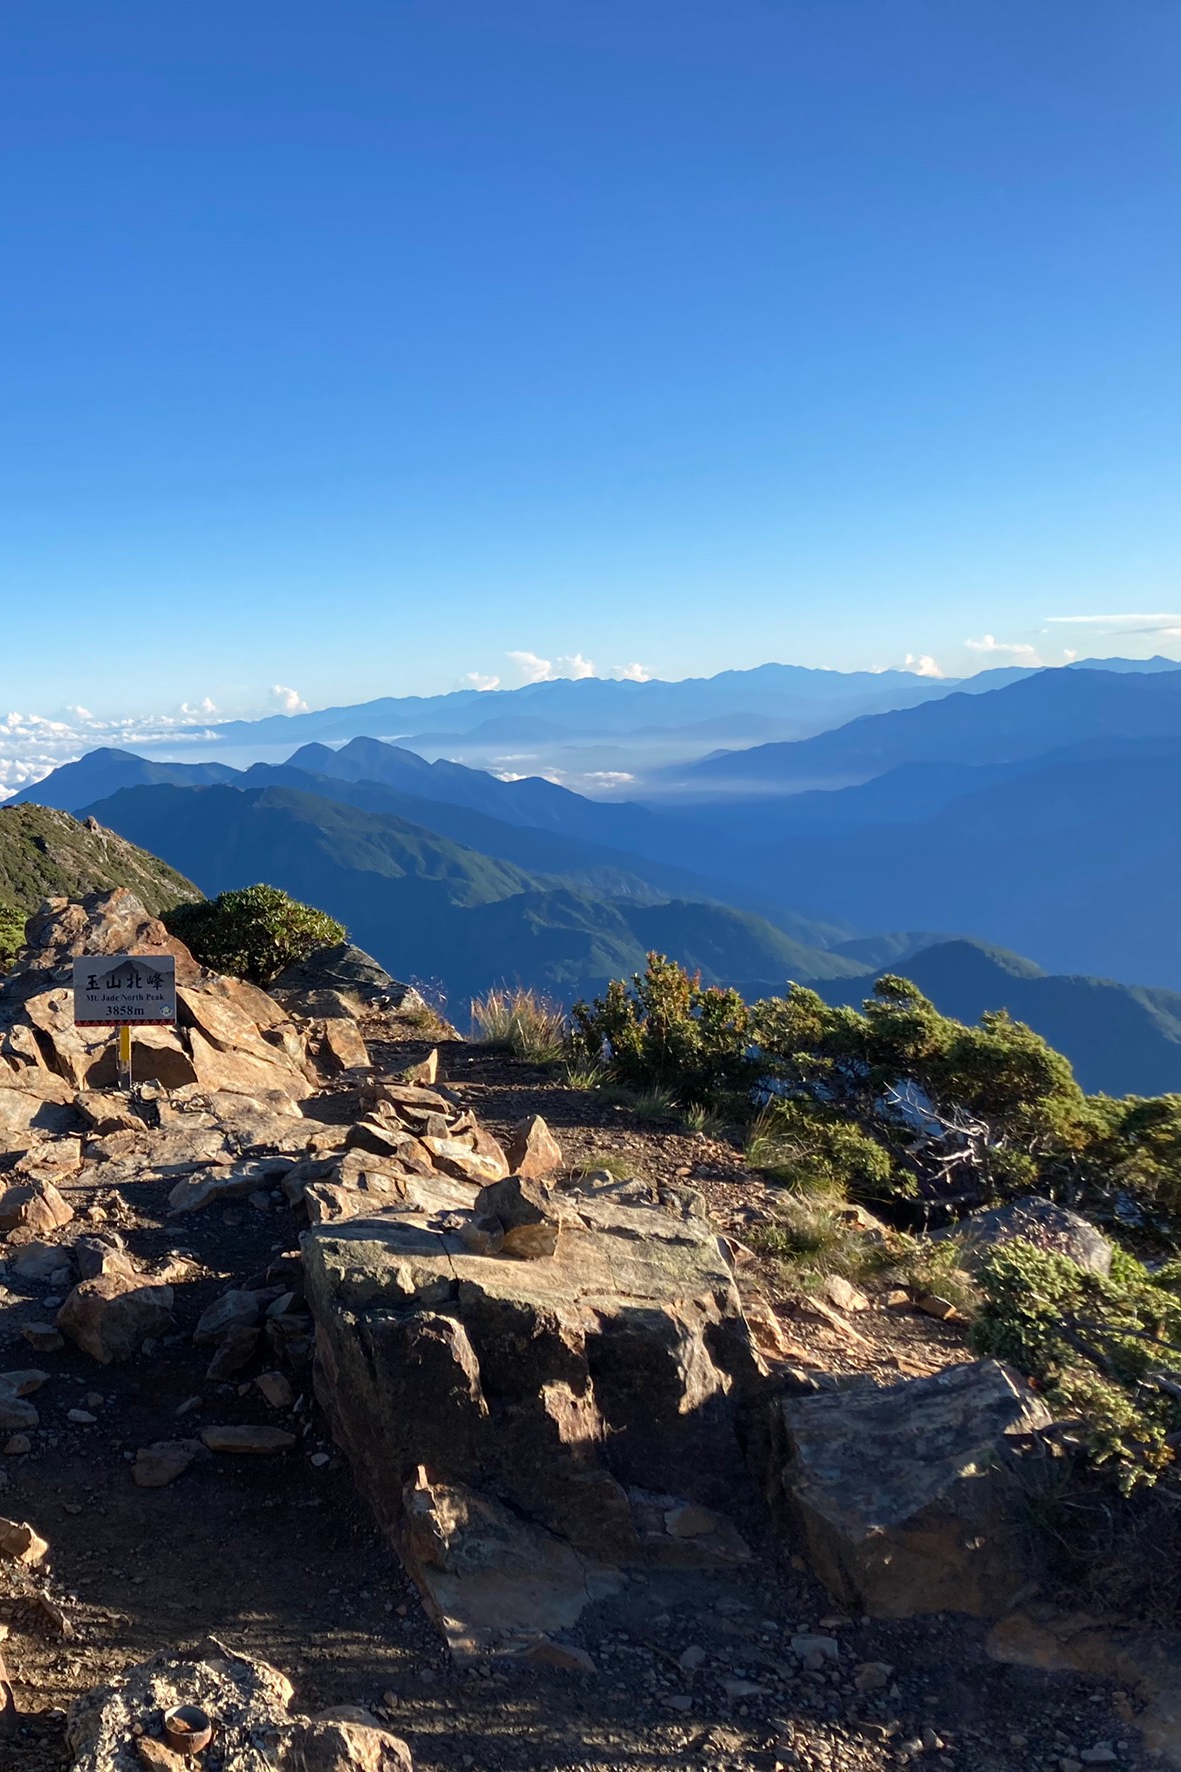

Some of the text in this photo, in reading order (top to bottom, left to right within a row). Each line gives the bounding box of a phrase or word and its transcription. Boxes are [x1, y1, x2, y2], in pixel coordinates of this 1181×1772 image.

[86, 972, 165, 991] 玉山北峰
[146, 993, 164, 1001] Peak
[106, 1005, 144, 1016] 3858m
